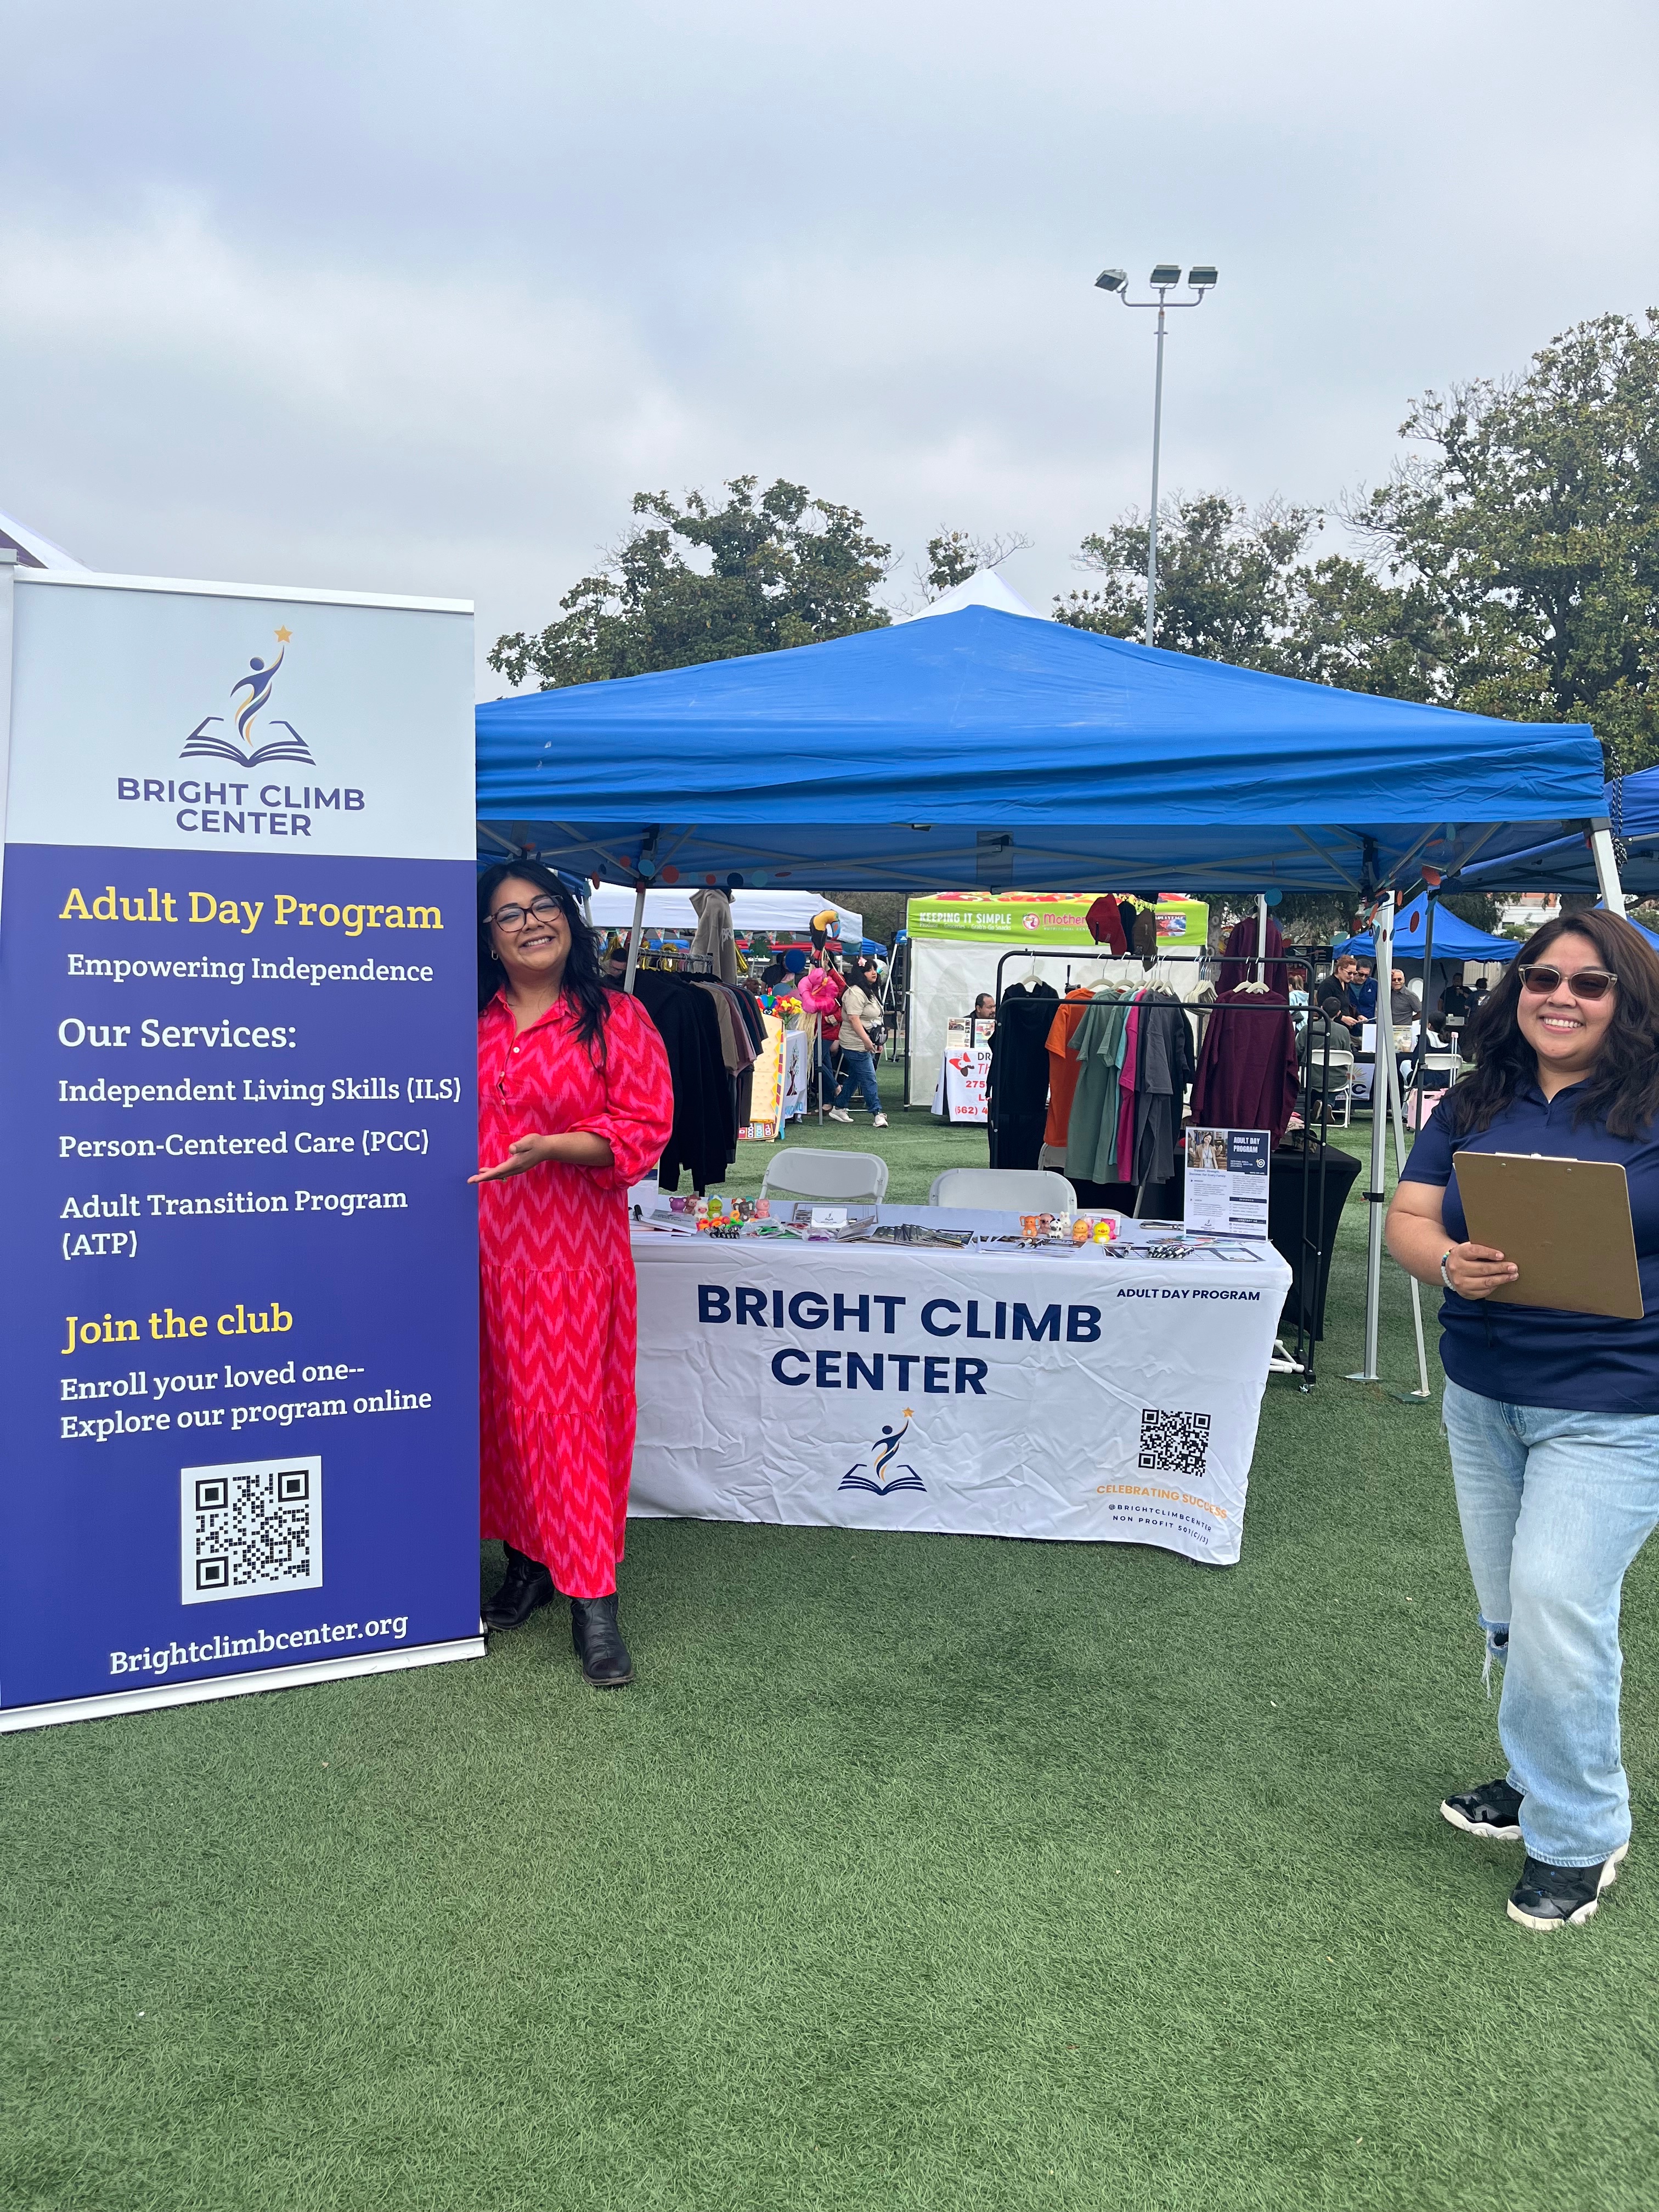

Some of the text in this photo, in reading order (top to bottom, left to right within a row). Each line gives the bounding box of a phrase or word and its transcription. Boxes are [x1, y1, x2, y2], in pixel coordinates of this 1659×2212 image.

[117, 777, 365, 811] BRIGHT CLIMB
[176, 809, 312, 837] CENTER
[59, 886, 444, 936] Adult Day Program
[919, 912, 1012, 924] KEEPING IT SIMPLE
[67, 953, 433, 986] Empowering Independence
[58, 1018, 296, 1048] Our Services:
[59, 1077, 461, 1108] Independent Living Skills (ILS)
[955, 1107, 978, 1115] (562)
[59, 1128, 429, 1158] Person-Centered Care (PCC)
[1233, 1145, 1258, 1153] PROGRAM
[59, 1190, 408, 1219] Adult Transition Program
[63, 1230, 137, 1261] (ATP)
[1116, 1289, 1260, 1301] ADULT DAY PROGRAM
[61, 1302, 293, 1355] Join the club
[697, 1284, 1102, 1342] BRIGHT CLIMB
[60, 1361, 365, 1401] Enroll your loved one--
[771, 1348, 988, 1395] CENTER
[60, 1389, 432, 1442] Explore our program online
[1097, 1485, 1227, 1519] CELEBRATING SUCCESS
[1108, 1504, 1212, 1532] @BRIGHTCLIMBCENTER
[1138, 1517, 1174, 1528] PROFIT
[1178, 1525, 1209, 1545] 501(C)(3)
[110, 1616, 409, 1675] Brightclimbcenter.org
